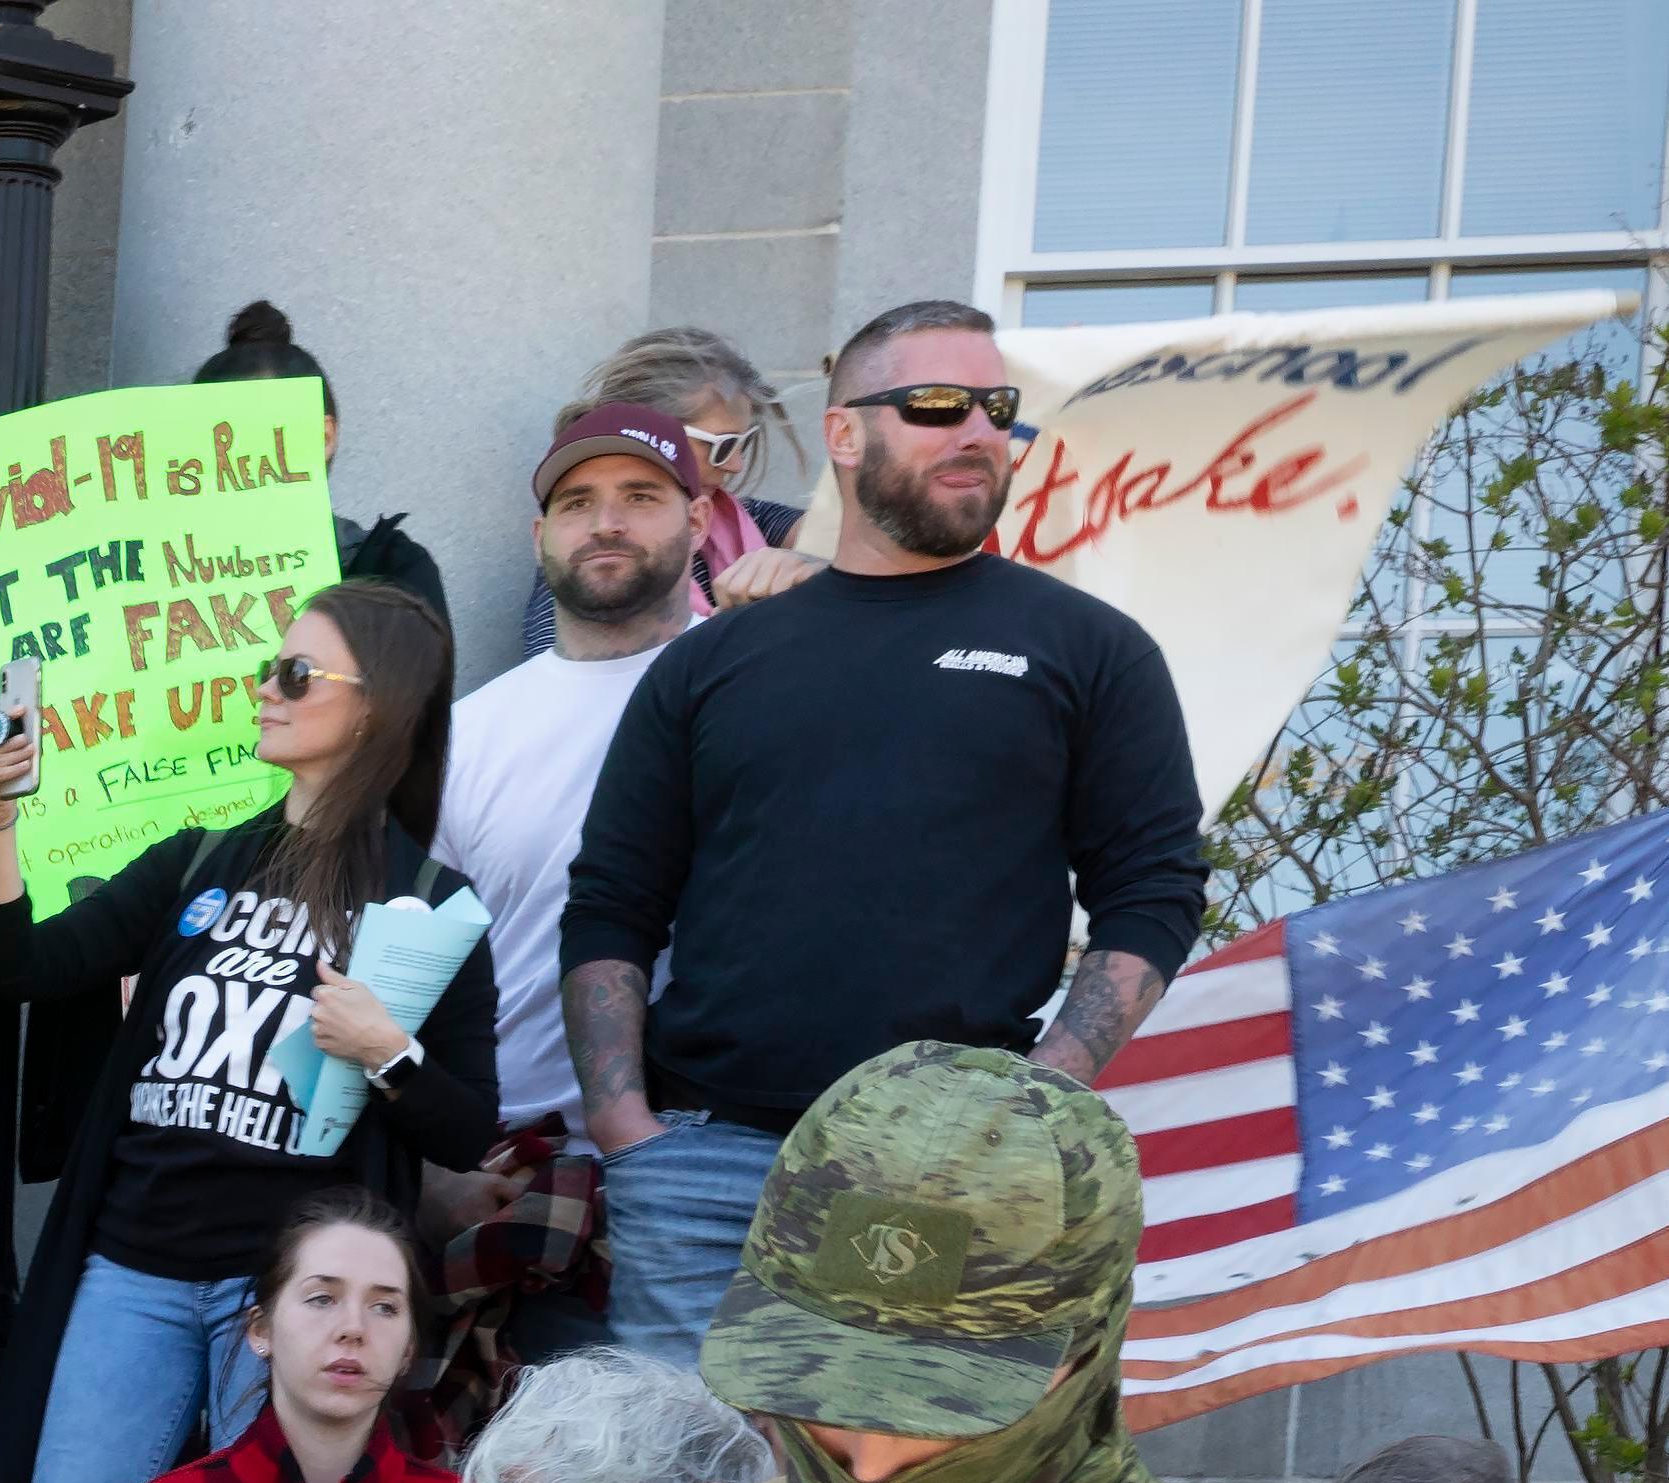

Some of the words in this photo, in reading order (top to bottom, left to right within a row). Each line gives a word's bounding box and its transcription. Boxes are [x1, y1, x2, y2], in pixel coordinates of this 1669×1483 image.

[45, 540, 145, 602] THE
[11, 612, 91, 663] ARE
[123, 585, 297, 672] FAKE
[97, 756, 186, 802] FALSE
[49, 820, 160, 869] operation
[184, 788, 255, 828] designed
[206, 947, 298, 986] are
[217, 1092, 286, 1150] HELL
